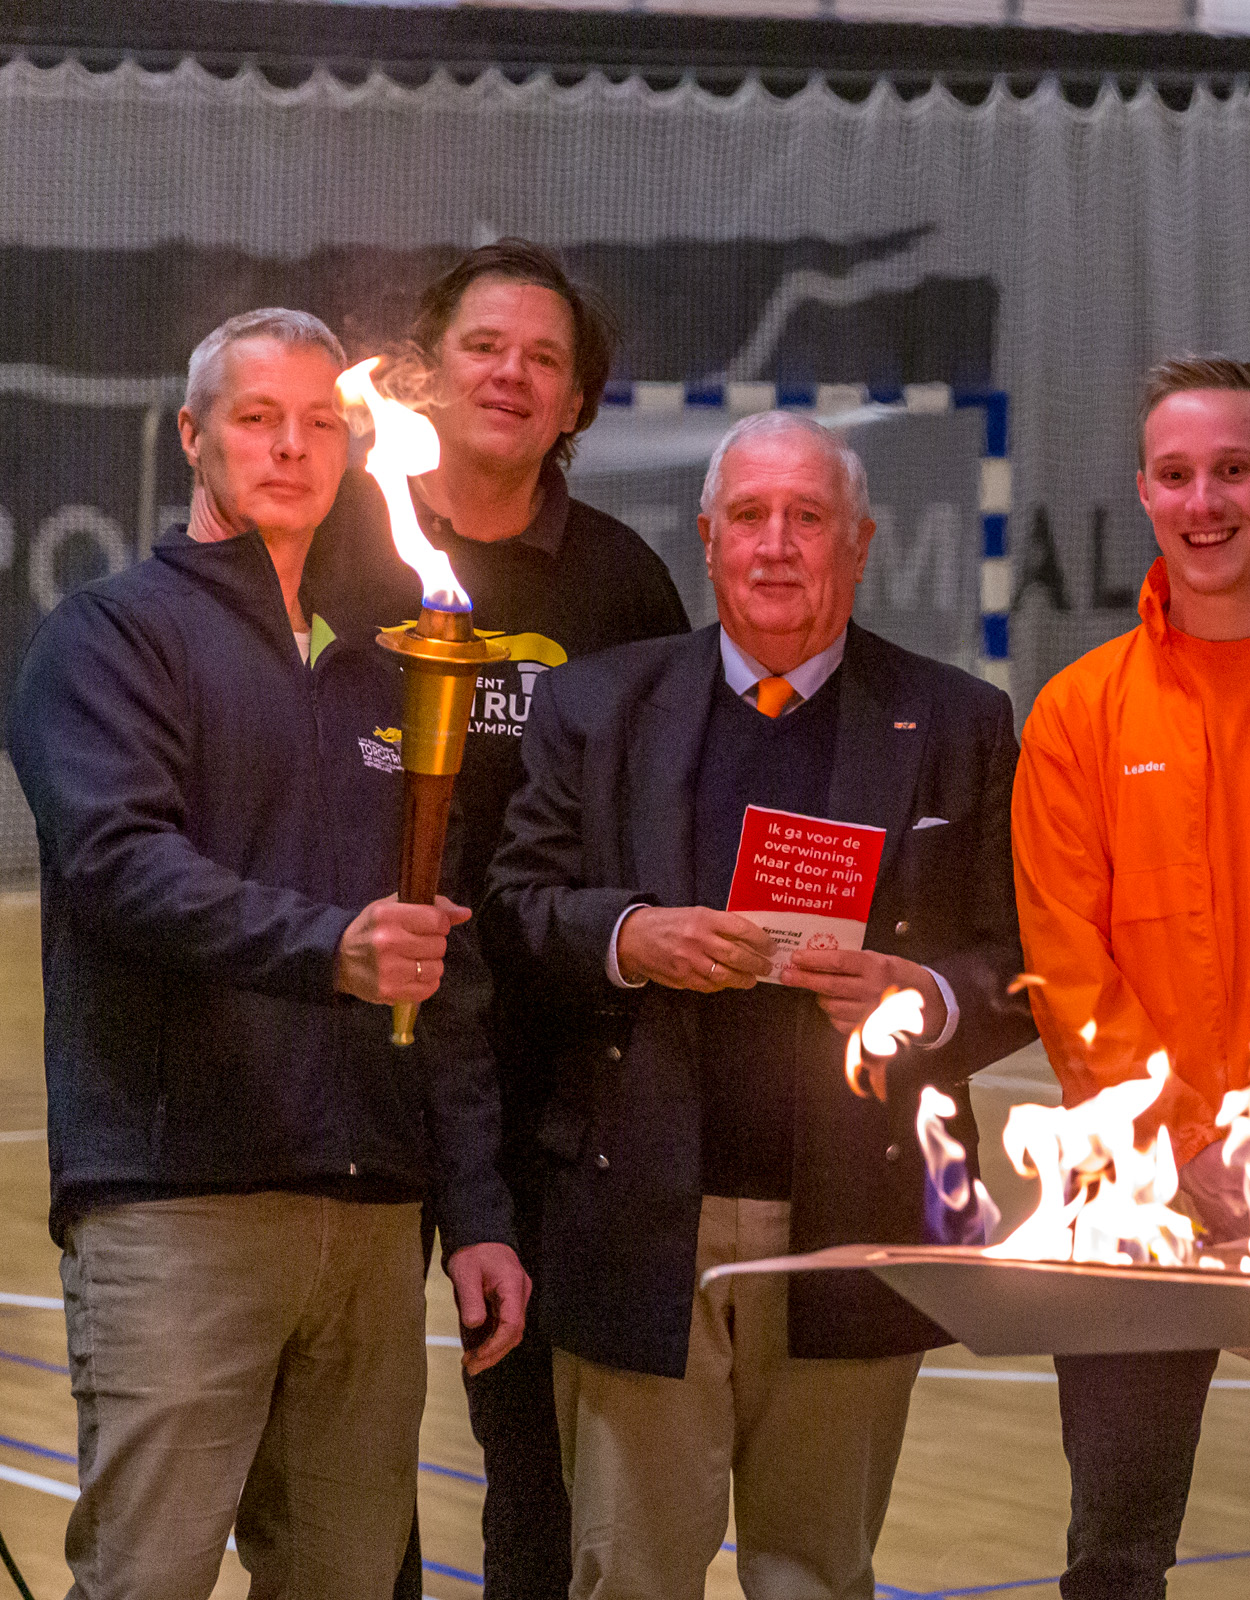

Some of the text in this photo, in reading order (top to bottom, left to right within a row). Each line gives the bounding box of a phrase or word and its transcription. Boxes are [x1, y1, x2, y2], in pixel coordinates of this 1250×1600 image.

[475, 676, 505, 690] ENT
[484, 691, 532, 722] RU
[467, 721, 523, 737] LYMPIC
[1124, 761, 1166, 775] Leader
[768, 823, 861, 850] Ik ga voor de
[764, 841, 858, 867] overwinning.
[753, 854, 863, 884] Maar door mijn
[754, 869, 856, 898] inzet ben ik al
[771, 892, 833, 911] winnaar!
[762, 926, 803, 938] Special
